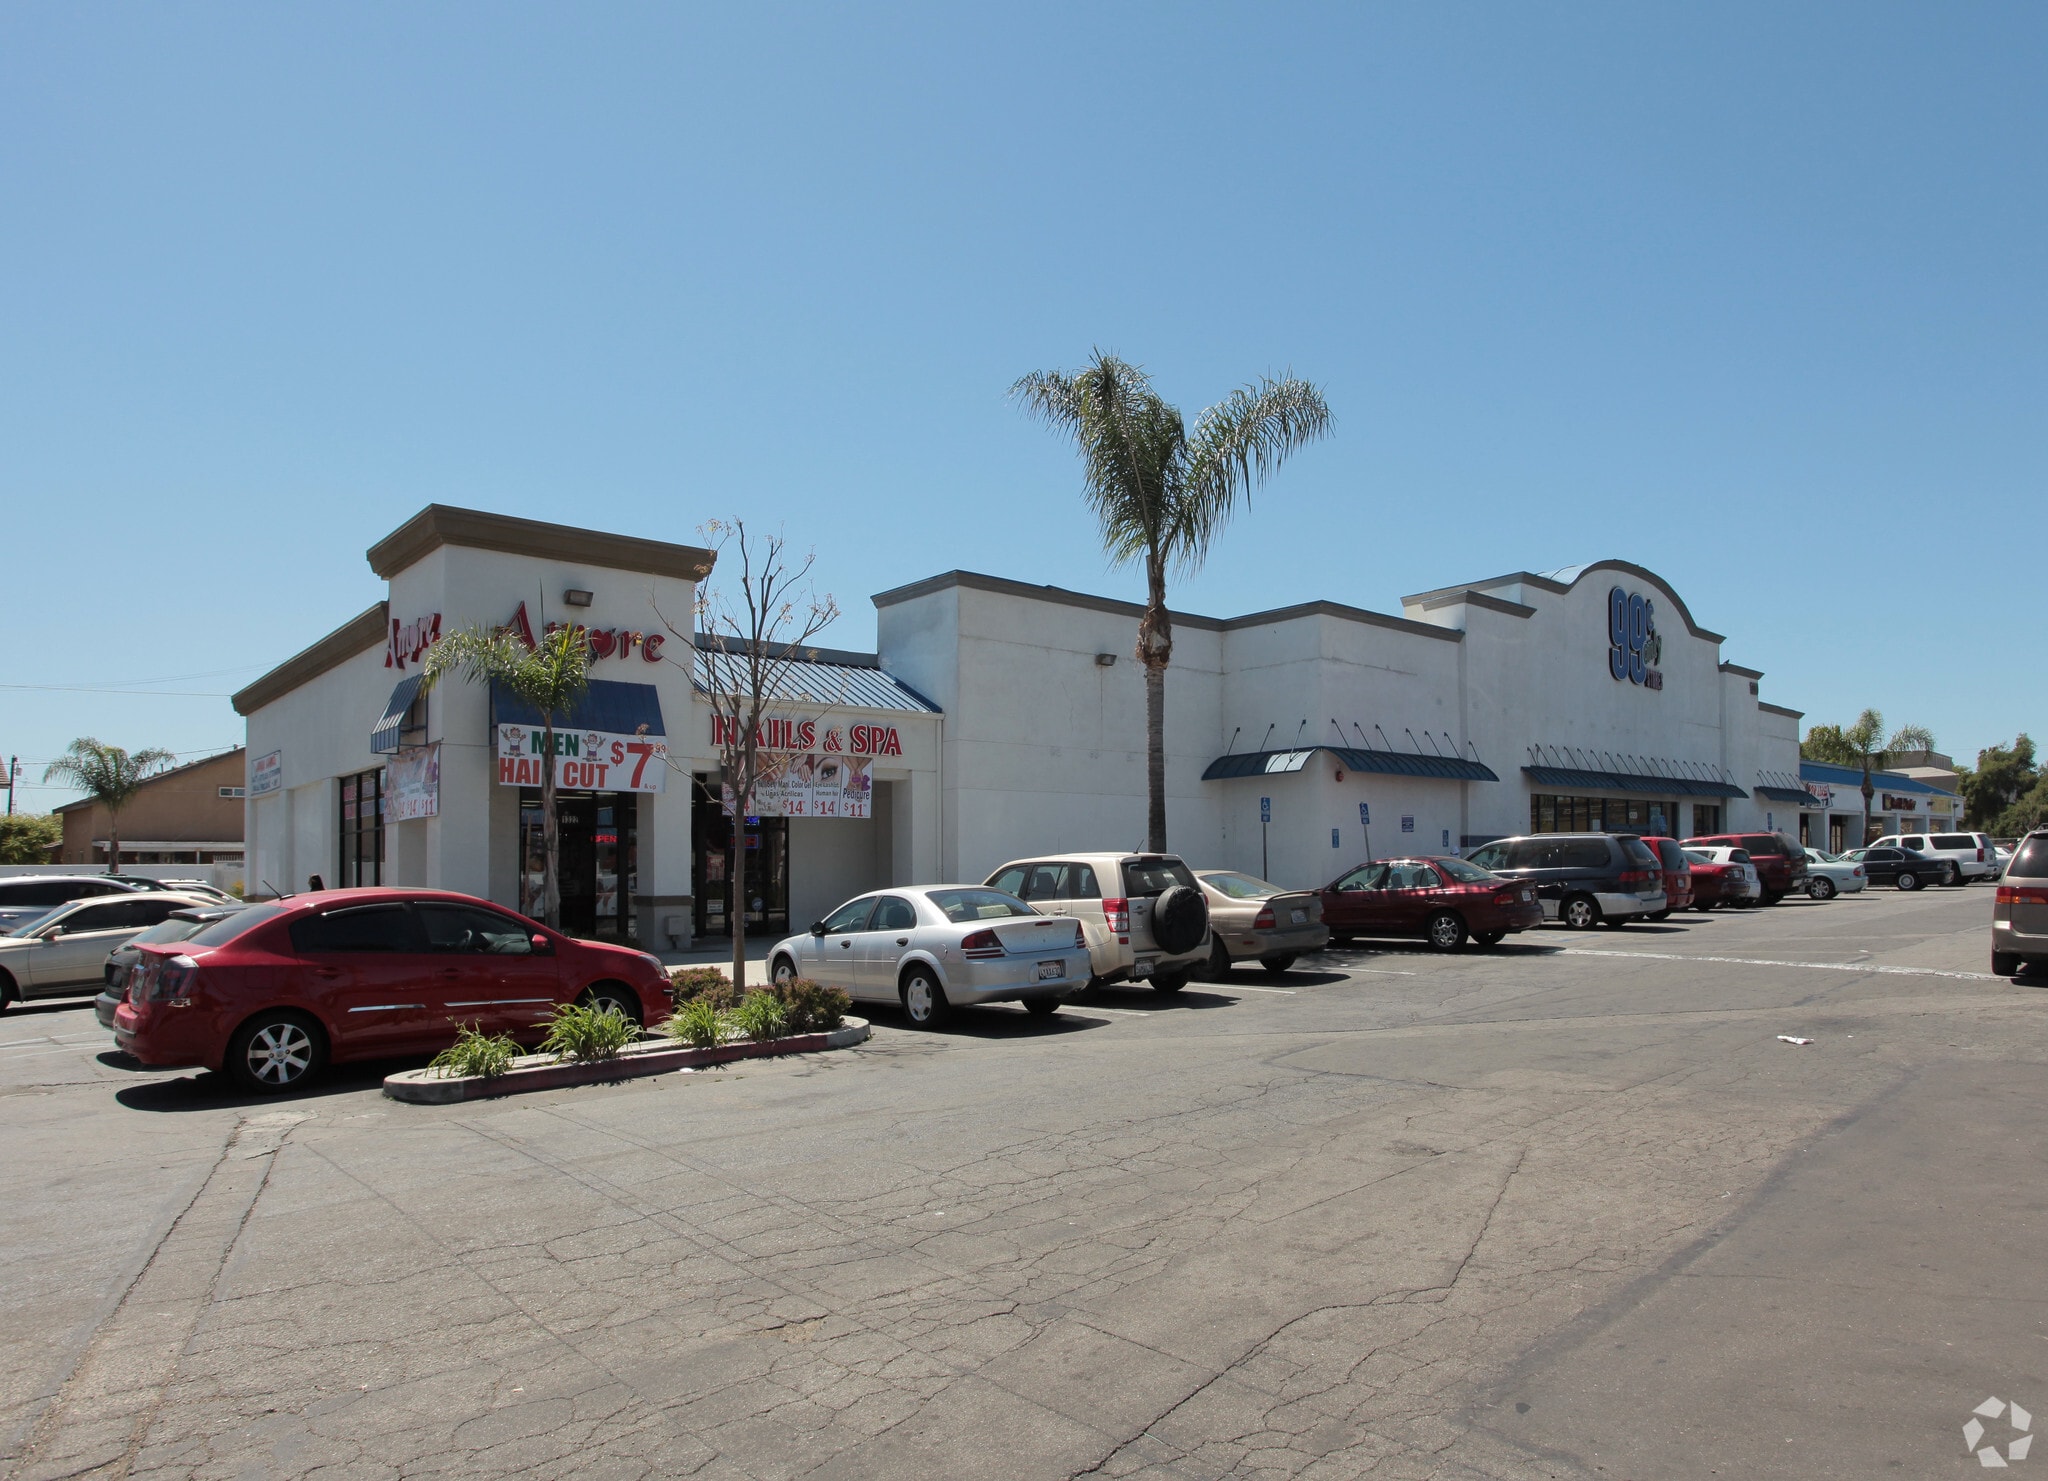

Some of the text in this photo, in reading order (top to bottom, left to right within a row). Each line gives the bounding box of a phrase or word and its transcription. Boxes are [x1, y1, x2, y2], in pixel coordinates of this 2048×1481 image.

[531, 730, 579, 757] MEN
[711, 713, 903, 756] NAILS & SPA
[499, 757, 609, 788] HAI CUT
[842, 787, 870, 800] Pedicure
